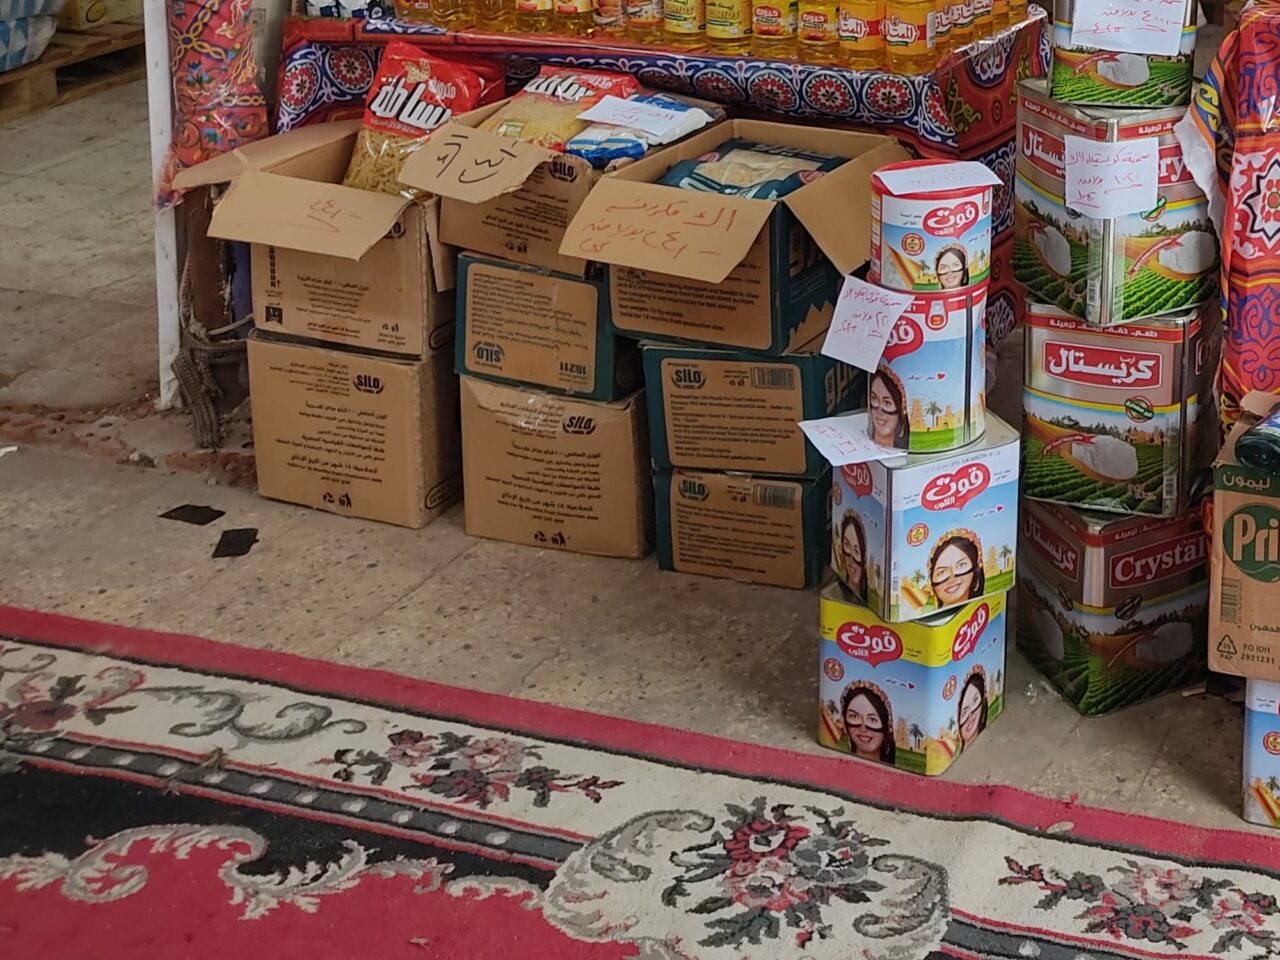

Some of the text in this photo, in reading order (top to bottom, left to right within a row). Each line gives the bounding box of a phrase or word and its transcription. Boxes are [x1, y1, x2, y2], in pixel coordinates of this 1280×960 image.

[552, 161, 574, 177] SILO
[928, 204, 977, 230] قوت
[476, 346, 501, 364] SILO
[1048, 347, 1156, 384] كريستال
[356, 374, 381, 390] SILO
[674, 368, 702, 385] SILO
[566, 415, 594, 431] SILO
[681, 479, 706, 497] SILO
[925, 467, 986, 500] قوت
[1223, 475, 1270, 489] ليمون
[1114, 537, 1206, 583] Crystal
[840, 625, 898, 652] قوت
